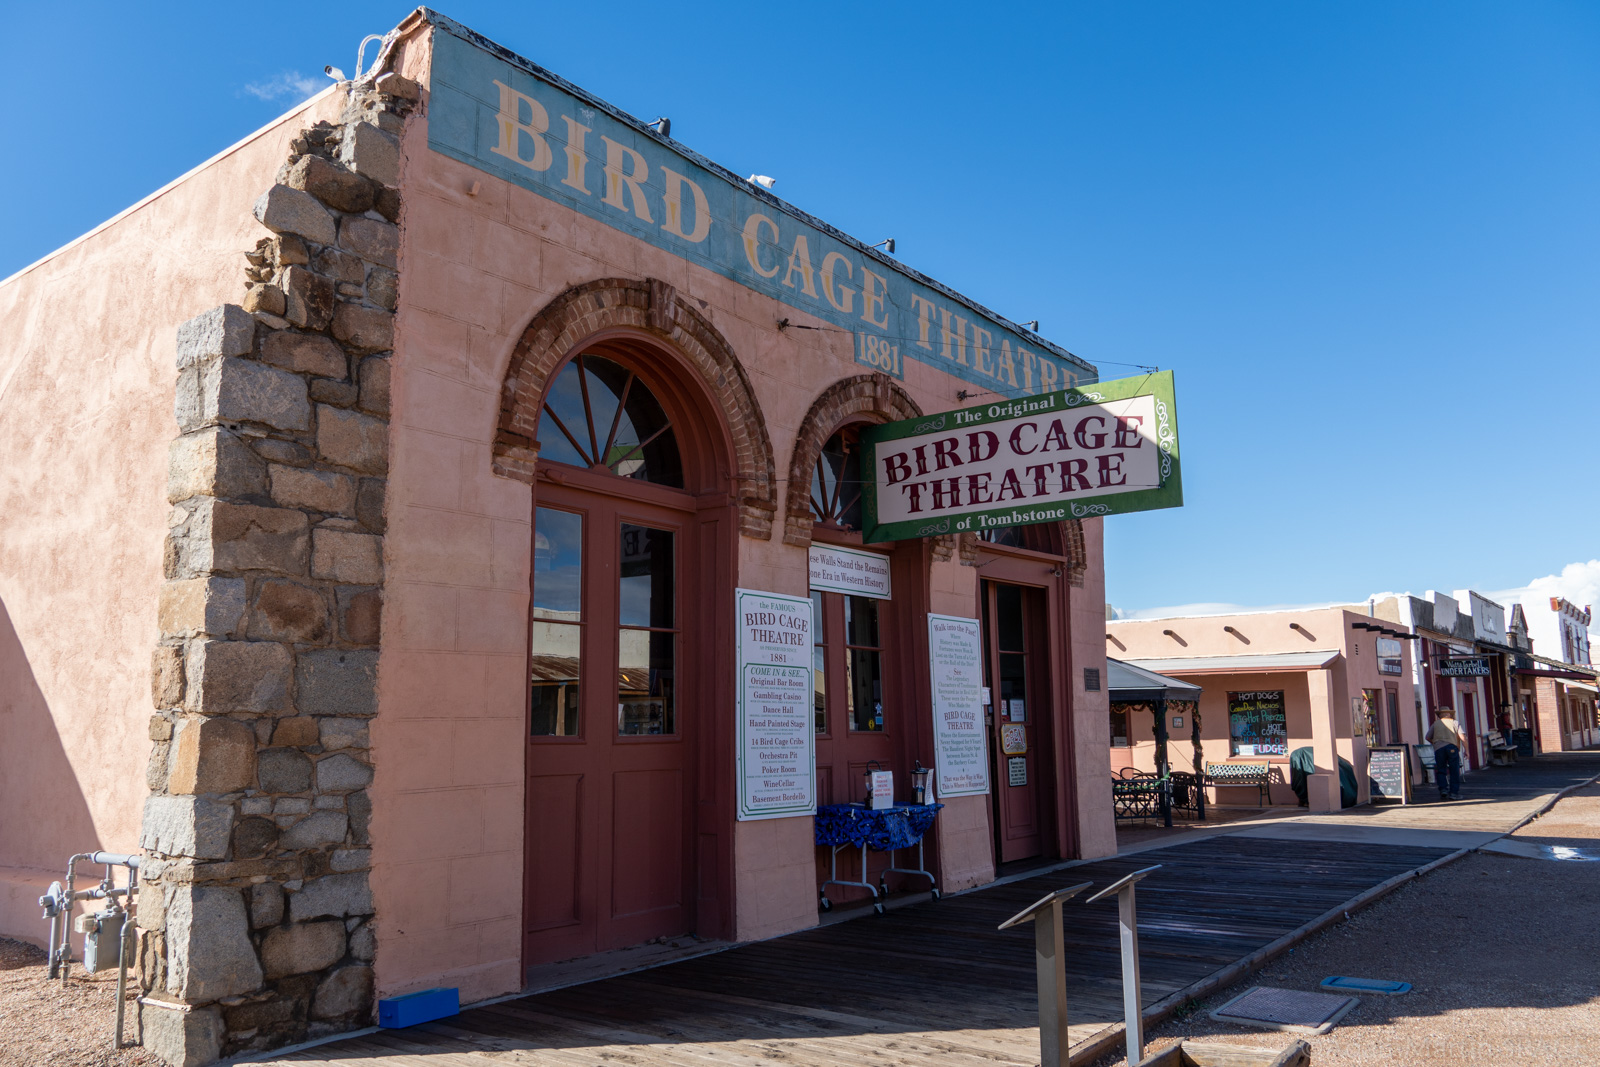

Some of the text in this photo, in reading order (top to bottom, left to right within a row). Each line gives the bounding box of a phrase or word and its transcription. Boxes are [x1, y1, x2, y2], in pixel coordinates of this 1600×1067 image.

[490, 79, 713, 243] BIRD
[740, 213, 889, 330] CAGE
[858, 332, 902, 376] 1881
[954, 396, 1056, 424] The Original
[882, 415, 1144, 486] BIRD CAGE
[902, 452, 1127, 514] THEATRE
[956, 506, 1066, 530] of Tombstone
[810, 554, 887, 575] ese Walls Stand the Remains
[822, 569, 833, 580] Era
[834, 572, 840, 581] in
[841, 572, 864, 586] Western
[865, 576, 884, 590] History
[760, 601, 796, 612] the FAMOUS
[745, 612, 808, 632] BIRD CAGE
[934, 624, 946, 632] Walk
[965, 626, 976, 637] Past!
[751, 629, 804, 646] THEATRE
[770, 653, 786, 662] 1881
[750, 667, 771, 676] COME
[772, 668, 780, 676] IN
[1441, 667, 1489, 675] UNDERTAKERS
[750, 677, 776, 686] Original
[753, 691, 782, 701] Gambling
[944, 711, 975, 721] BIRD CAGE
[790, 720, 805, 728] Stage
[947, 722, 974, 730] THEATRE
[775, 738, 788, 746] Cage
[1253, 744, 1284, 754] FUDGE
[782, 793, 806, 801] Bordello
